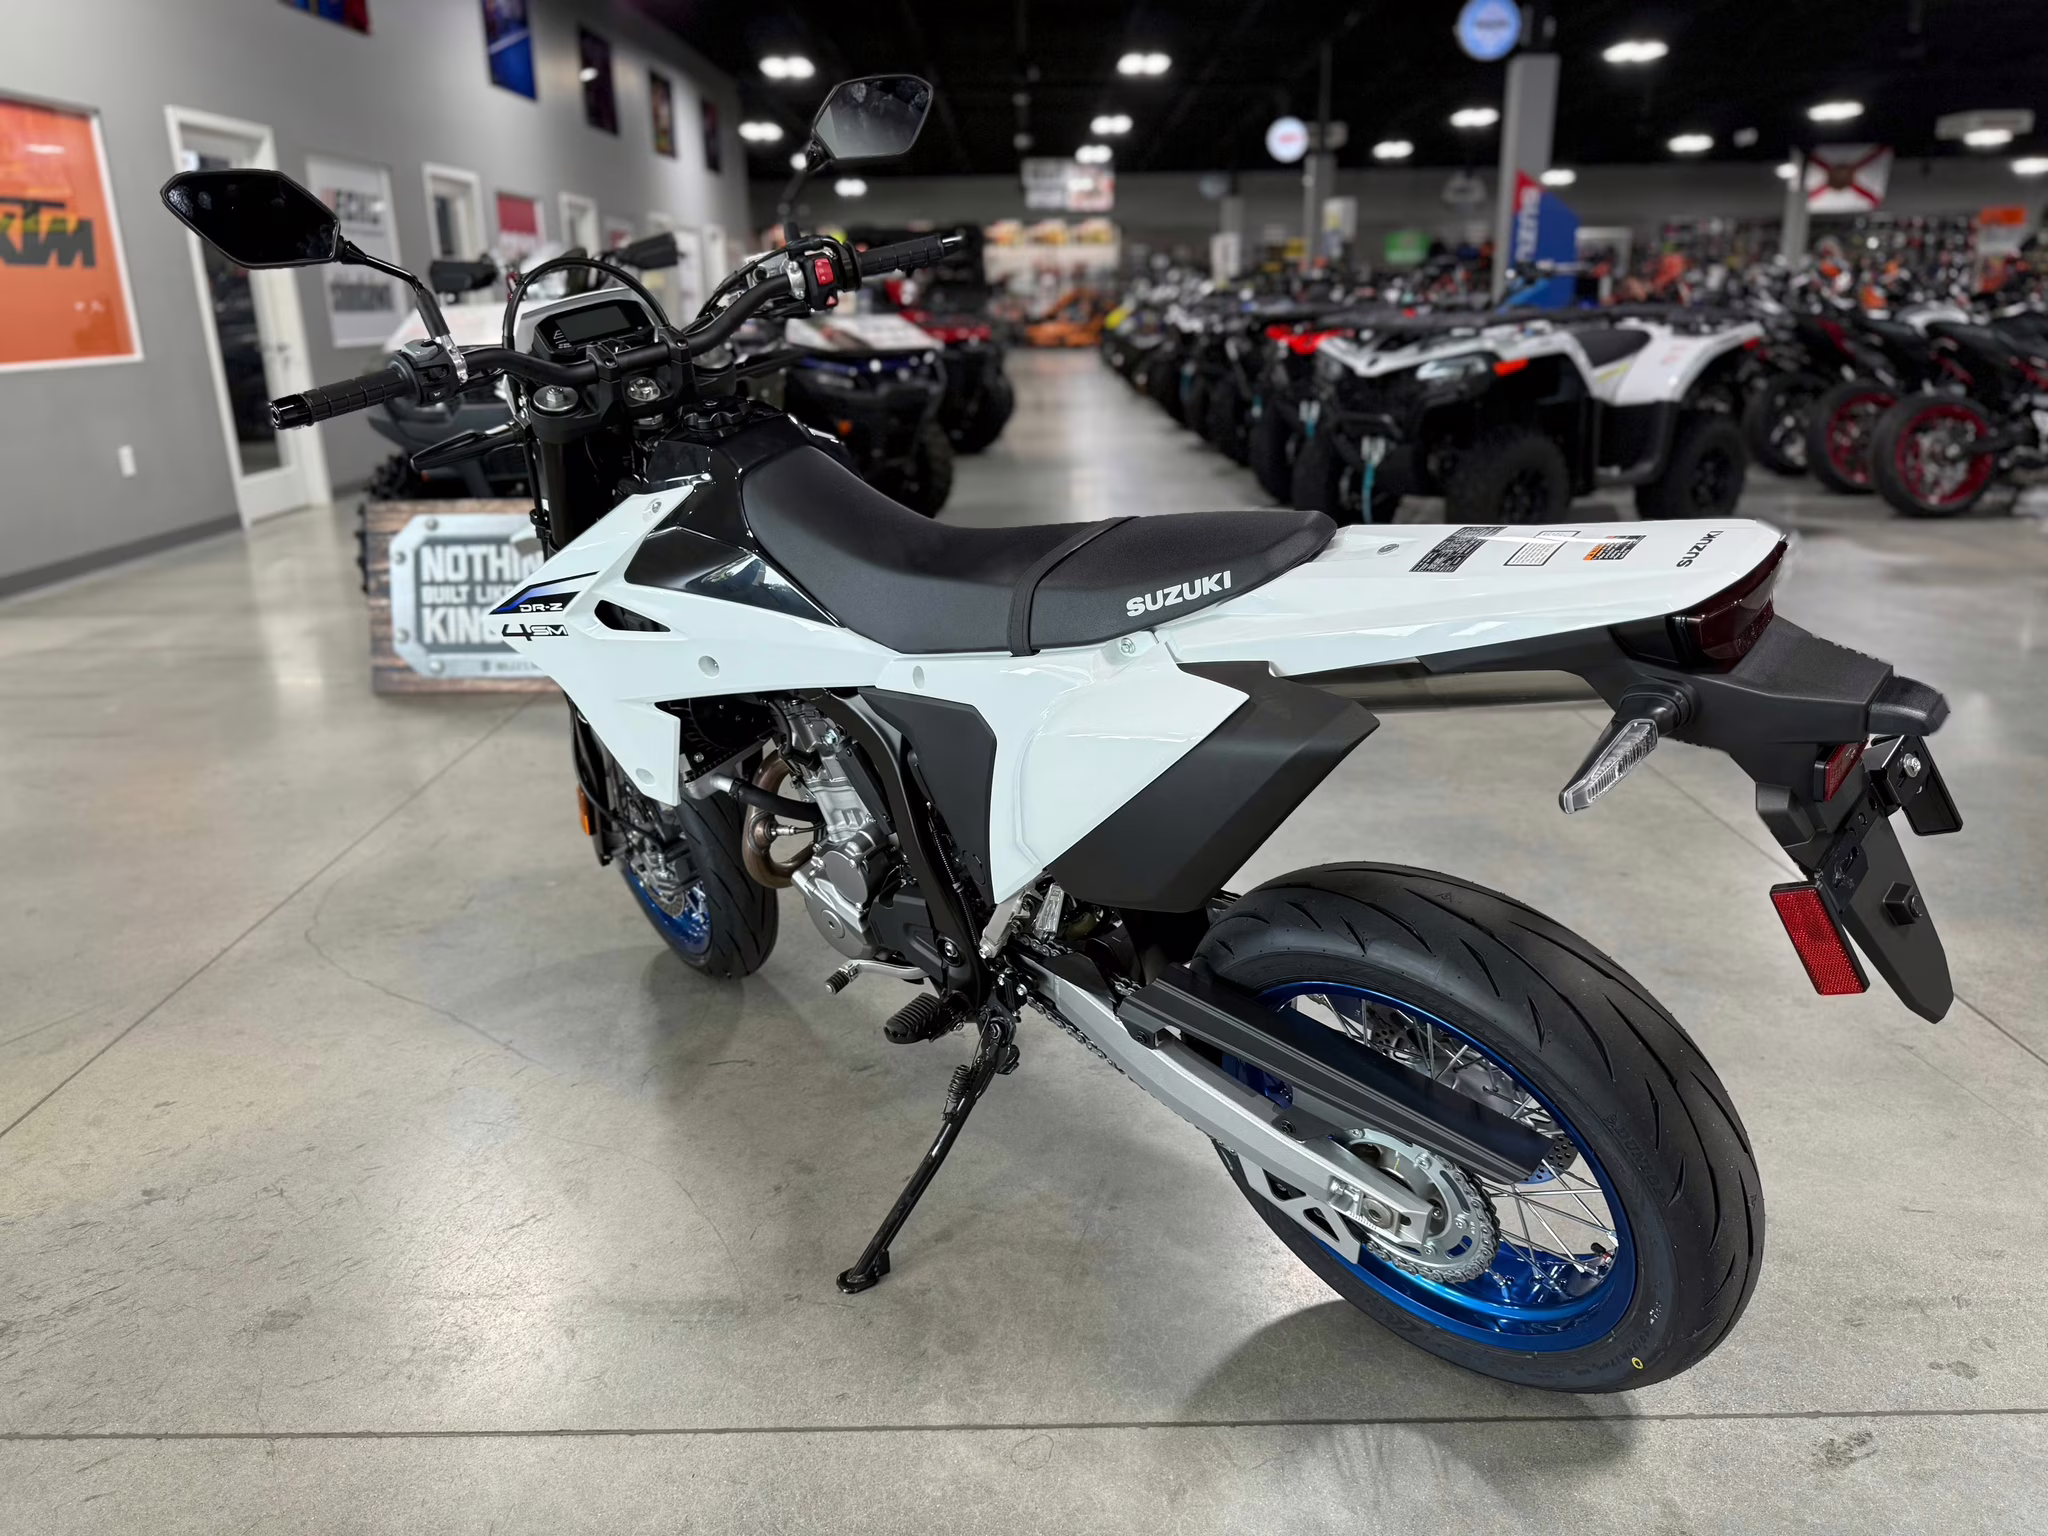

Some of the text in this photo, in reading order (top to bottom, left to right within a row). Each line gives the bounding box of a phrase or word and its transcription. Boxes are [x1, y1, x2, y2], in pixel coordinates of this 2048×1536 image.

[420, 544, 545, 581] NOTHIN
[1676, 530, 1724, 568] SUZUKI
[420, 584, 471, 604] BUILT
[519, 602, 563, 613] DR-Z
[1126, 570, 1231, 617] SUZUKI
[502, 623, 569, 641] 4SM
